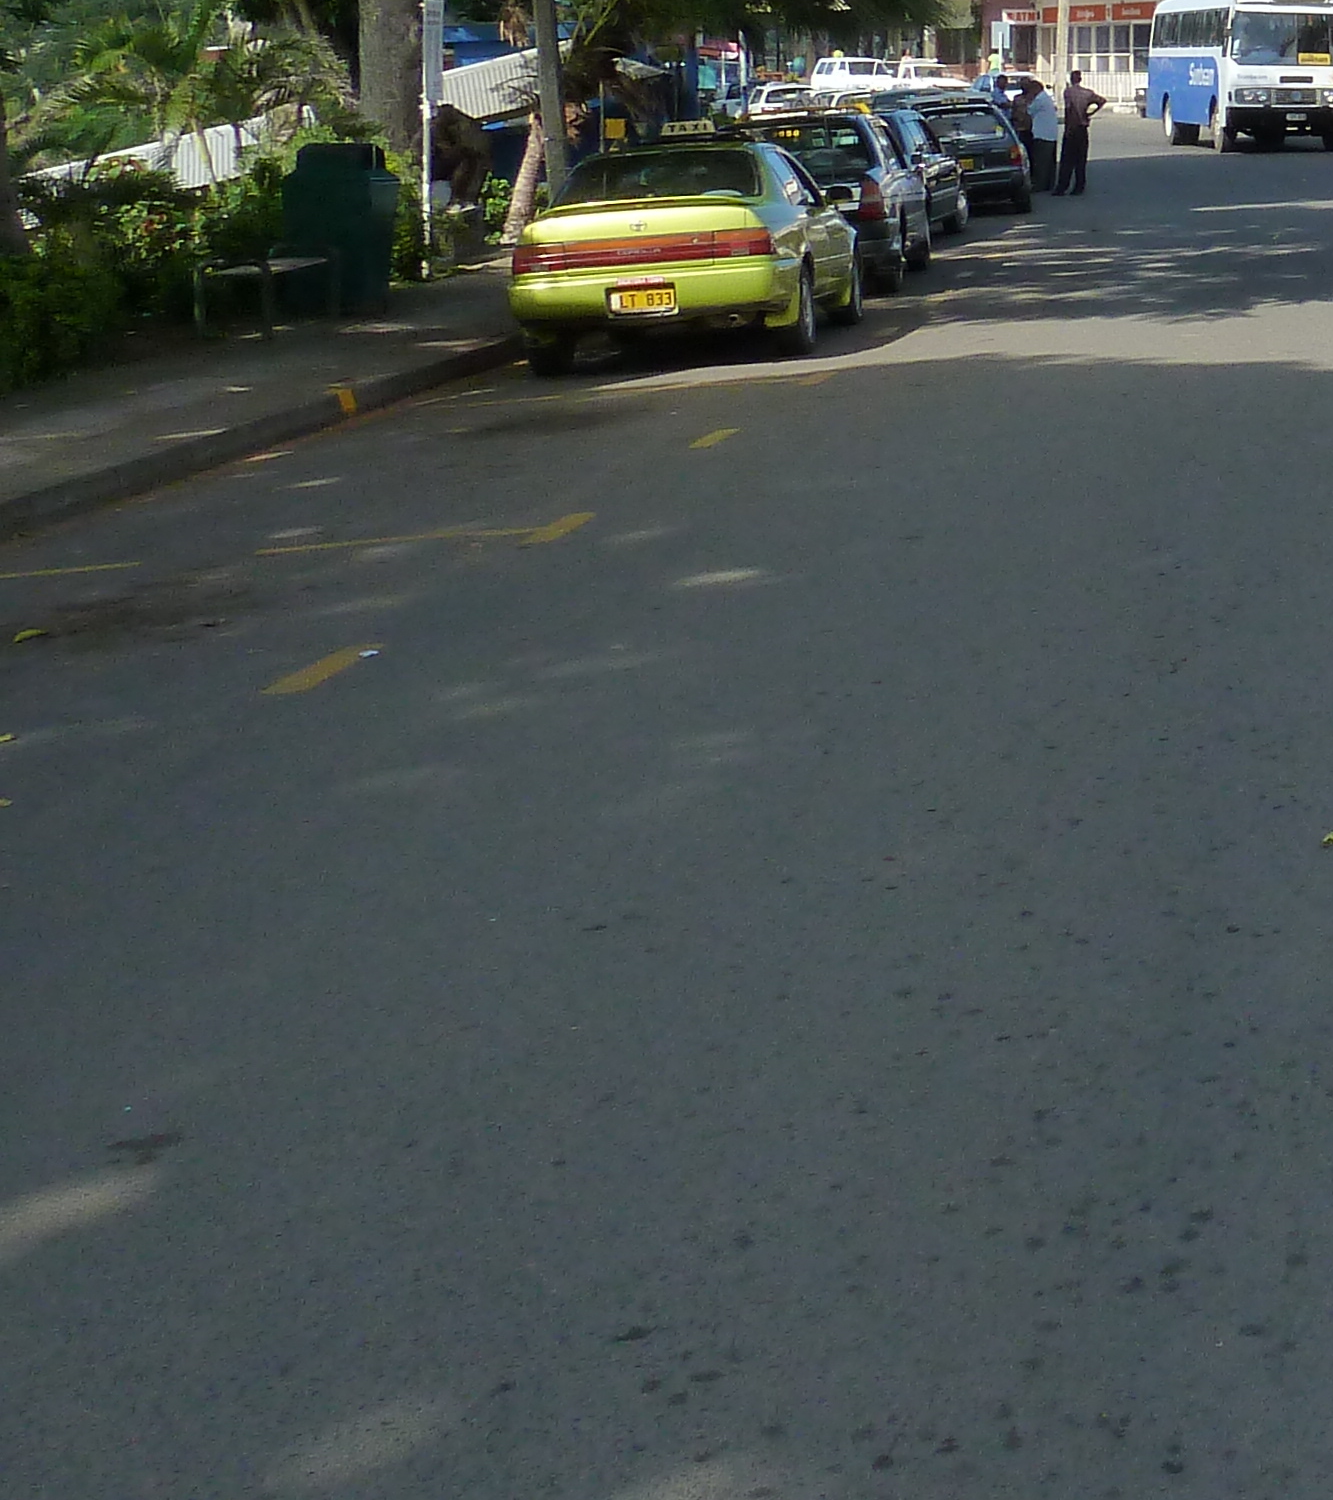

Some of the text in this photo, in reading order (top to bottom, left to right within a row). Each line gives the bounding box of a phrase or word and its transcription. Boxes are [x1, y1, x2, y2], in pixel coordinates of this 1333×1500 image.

[667, 122, 708, 133] TAXI
[620, 292, 672, 308] LT 833
